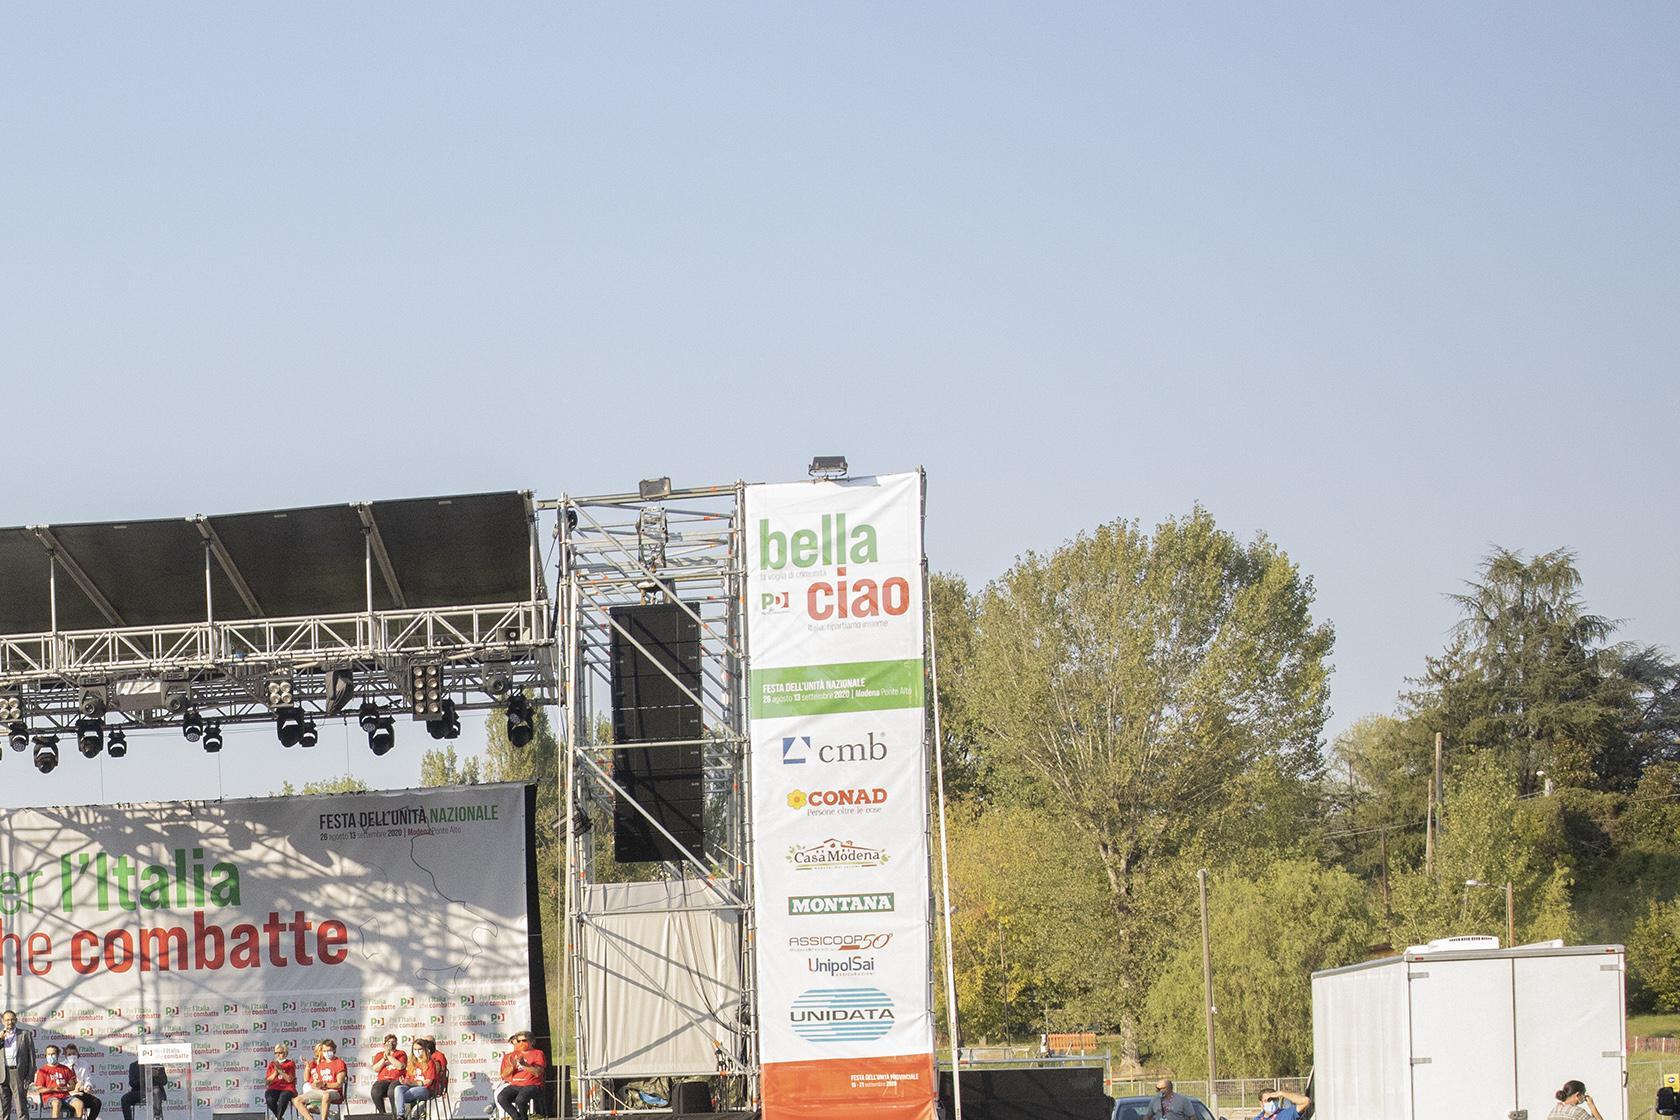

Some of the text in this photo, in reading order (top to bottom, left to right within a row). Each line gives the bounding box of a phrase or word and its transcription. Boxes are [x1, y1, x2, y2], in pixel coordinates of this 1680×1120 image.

[759, 512, 878, 571] bella
[807, 566, 910, 621] ciao
[762, 683, 785, 694] FESTA
[826, 677, 866, 689] NAZIONALE
[833, 690, 849, 699] 2020
[855, 688, 880, 697] Modena
[819, 732, 888, 763] cmb
[808, 788, 887, 807] CONAD
[320, 805, 499, 830] FESTA DELL'UNITÀ NAZIONALE
[320, 832, 328, 841] 26
[329, 831, 349, 841] agosto
[350, 831, 356, 839] 13
[387, 829, 402, 838] 2020
[407, 827, 432, 836] Modena
[794, 850, 880, 864] Casa Modena
[60, 847, 241, 913] l'Italia
[792, 895, 892, 913] MONTANA
[70, 910, 349, 976] combatte
[789, 934, 863, 947] ASSICOOP
[808, 955, 875, 977] UnipolSai
[790, 1009, 895, 1022] UNIDATA
